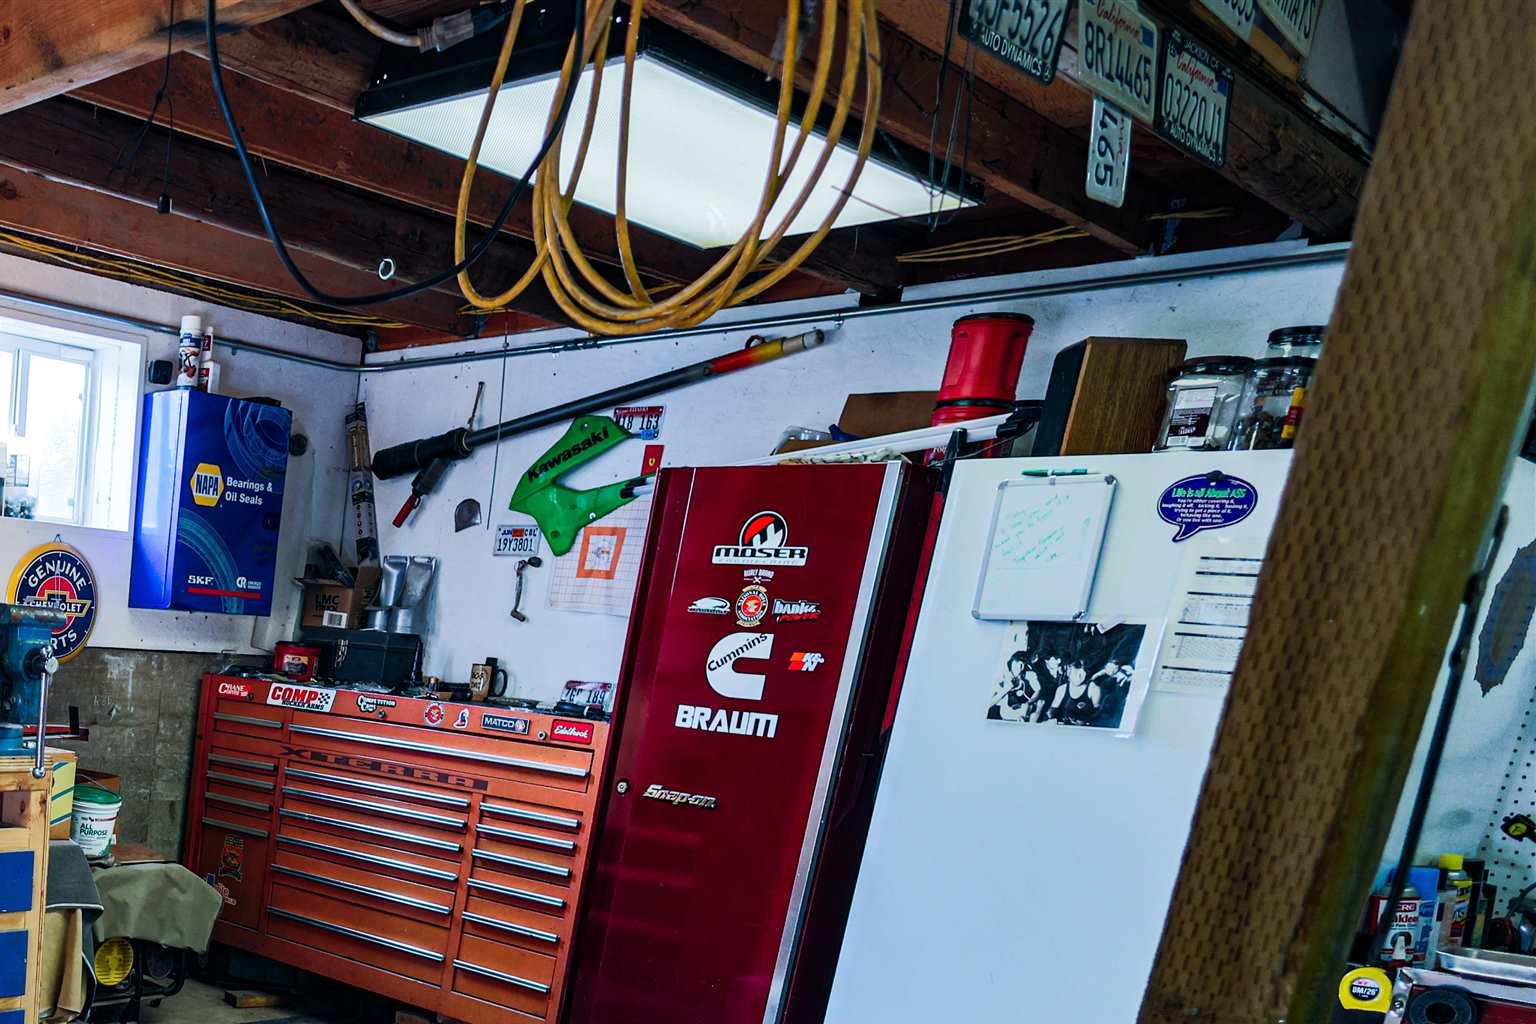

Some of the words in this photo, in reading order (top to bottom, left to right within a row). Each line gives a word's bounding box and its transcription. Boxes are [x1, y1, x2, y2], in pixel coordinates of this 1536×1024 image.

[1000, 39, 1043, 76] DYNAMICS
[1084, 20, 1151, 105] 8R14465
[527, 425, 610, 483] Kawasaki
[195, 474, 219, 497] NAPA
[226, 476, 265, 492] Bearings
[266, 482, 273, 493] &
[225, 490, 237, 502] Oil
[239, 493, 263, 506] Seals
[714, 547, 807, 559] MOSER
[28, 559, 88, 592] GENUINE
[187, 574, 214, 586] SKF
[315, 593, 339, 605] LMC
[707, 632, 768, 672] Cummins
[271, 685, 319, 704] COMP
[484, 716, 515, 729] MATCO
[554, 725, 588, 739] Edelbrock
[643, 784, 717, 808] Snap-on
[80, 828, 108, 836] PURPOSE
